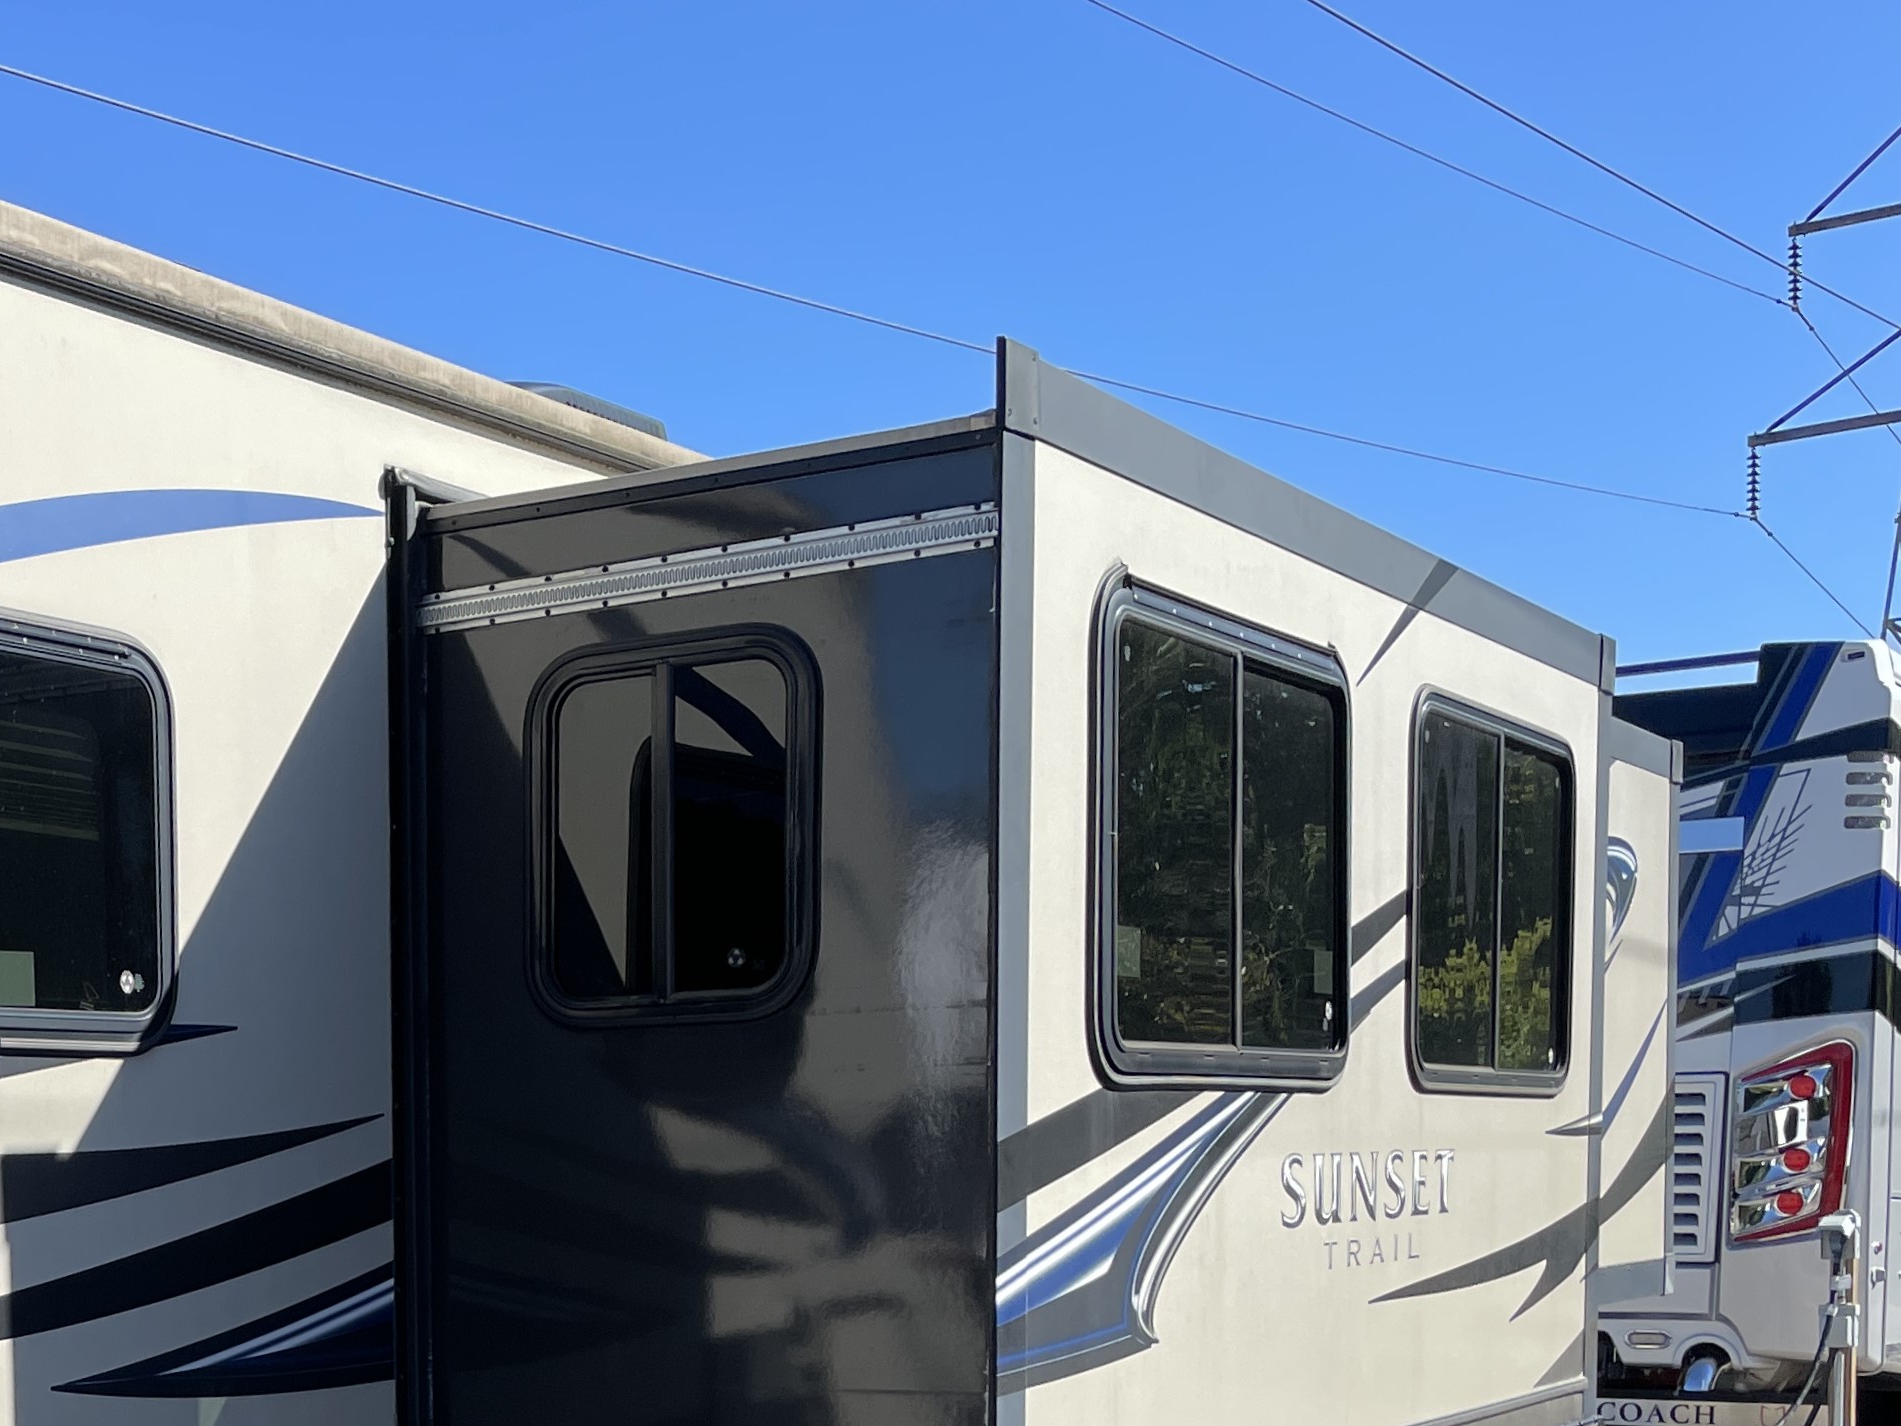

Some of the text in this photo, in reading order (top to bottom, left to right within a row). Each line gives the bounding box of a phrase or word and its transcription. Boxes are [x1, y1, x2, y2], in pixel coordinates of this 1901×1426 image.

[1280, 1149, 1456, 1229] SUNSET
[1323, 1232, 1420, 1270] TRAIL
[1597, 1401, 1716, 1425] COACH
